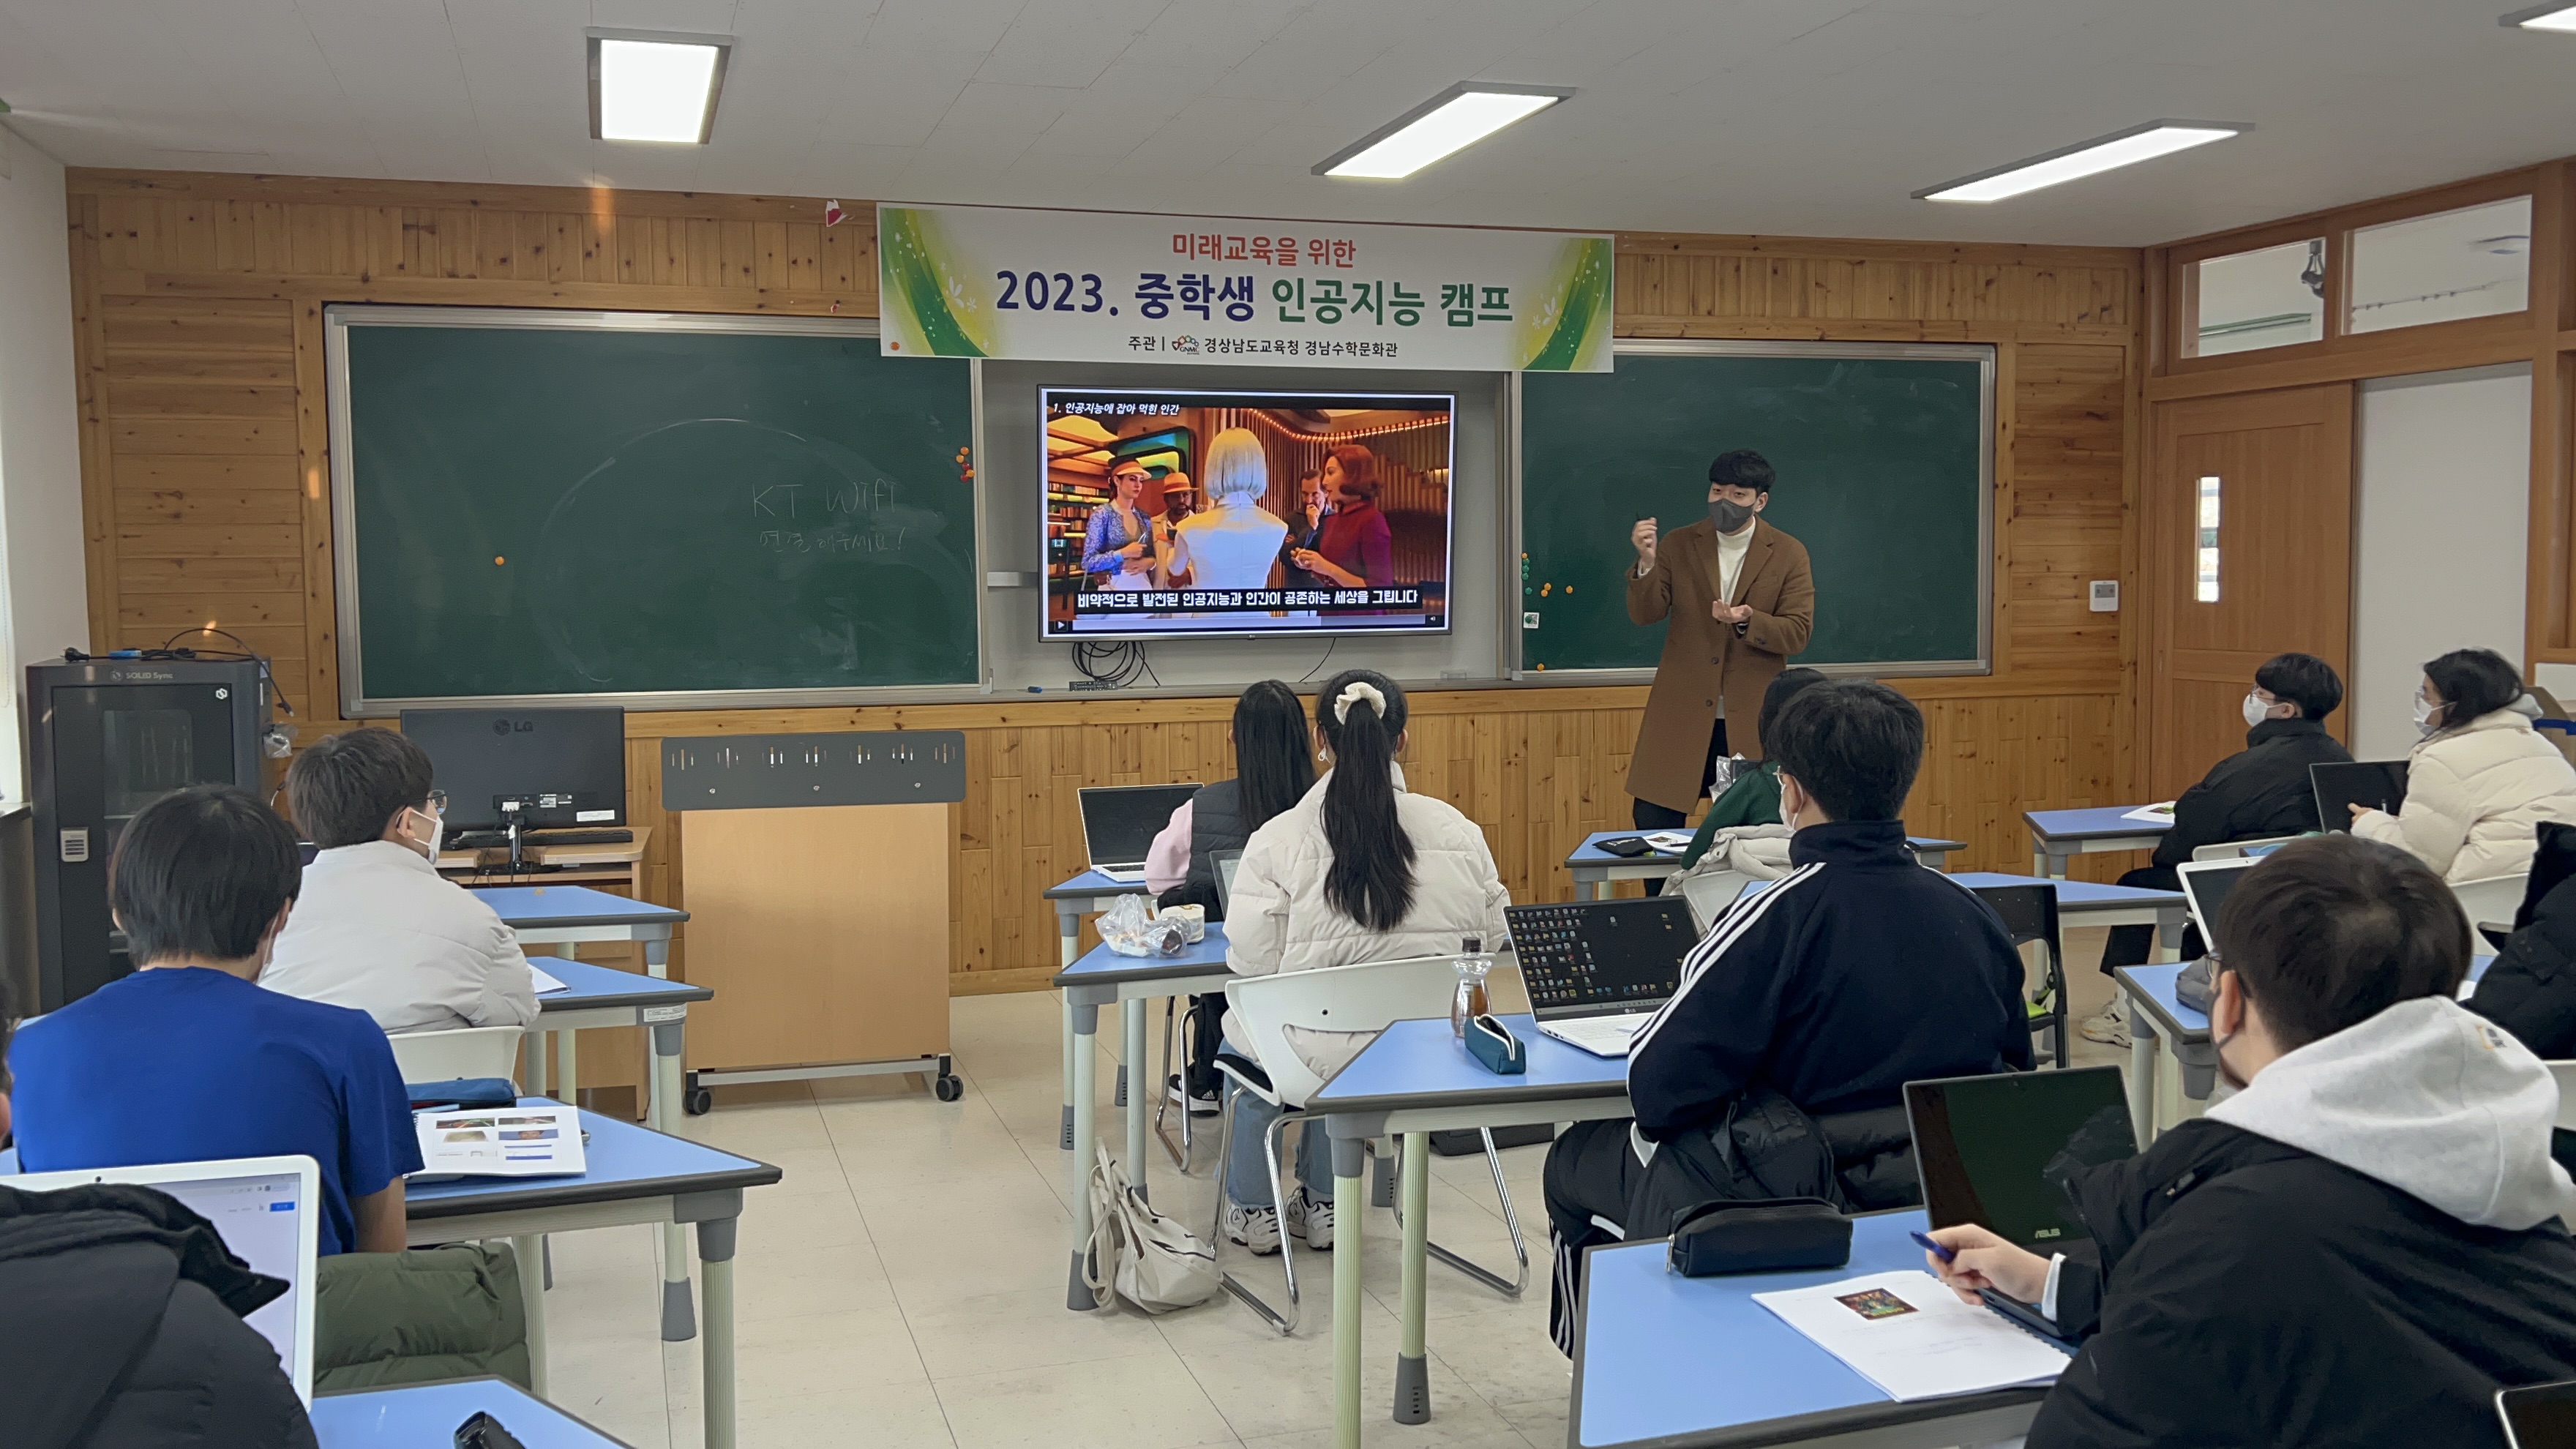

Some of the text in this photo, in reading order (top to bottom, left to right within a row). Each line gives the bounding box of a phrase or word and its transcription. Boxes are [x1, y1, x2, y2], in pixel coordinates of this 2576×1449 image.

[1172, 233, 1357, 269] 미래교육을 위한
[995, 270, 1514, 328] 2023. 중학생 인공지능 캠프
[1128, 336, 1156, 351] 주관
[1204, 337, 1300, 356] 경상남도교육청
[1304, 340, 1399, 358] 경남수학문화관
[1053, 402, 1180, 416] 1. 인공지능에 잡아 먹힌 인간
[752, 484, 804, 519] KT
[1077, 589, 1418, 607] 비약적으로 발전된 인공지능과 인간이 공존하는 세상을 그립니다
[154, 672, 173, 680] Sync
[514, 721, 533, 732] LG
[2034, 1227, 2062, 1239] ASUS
